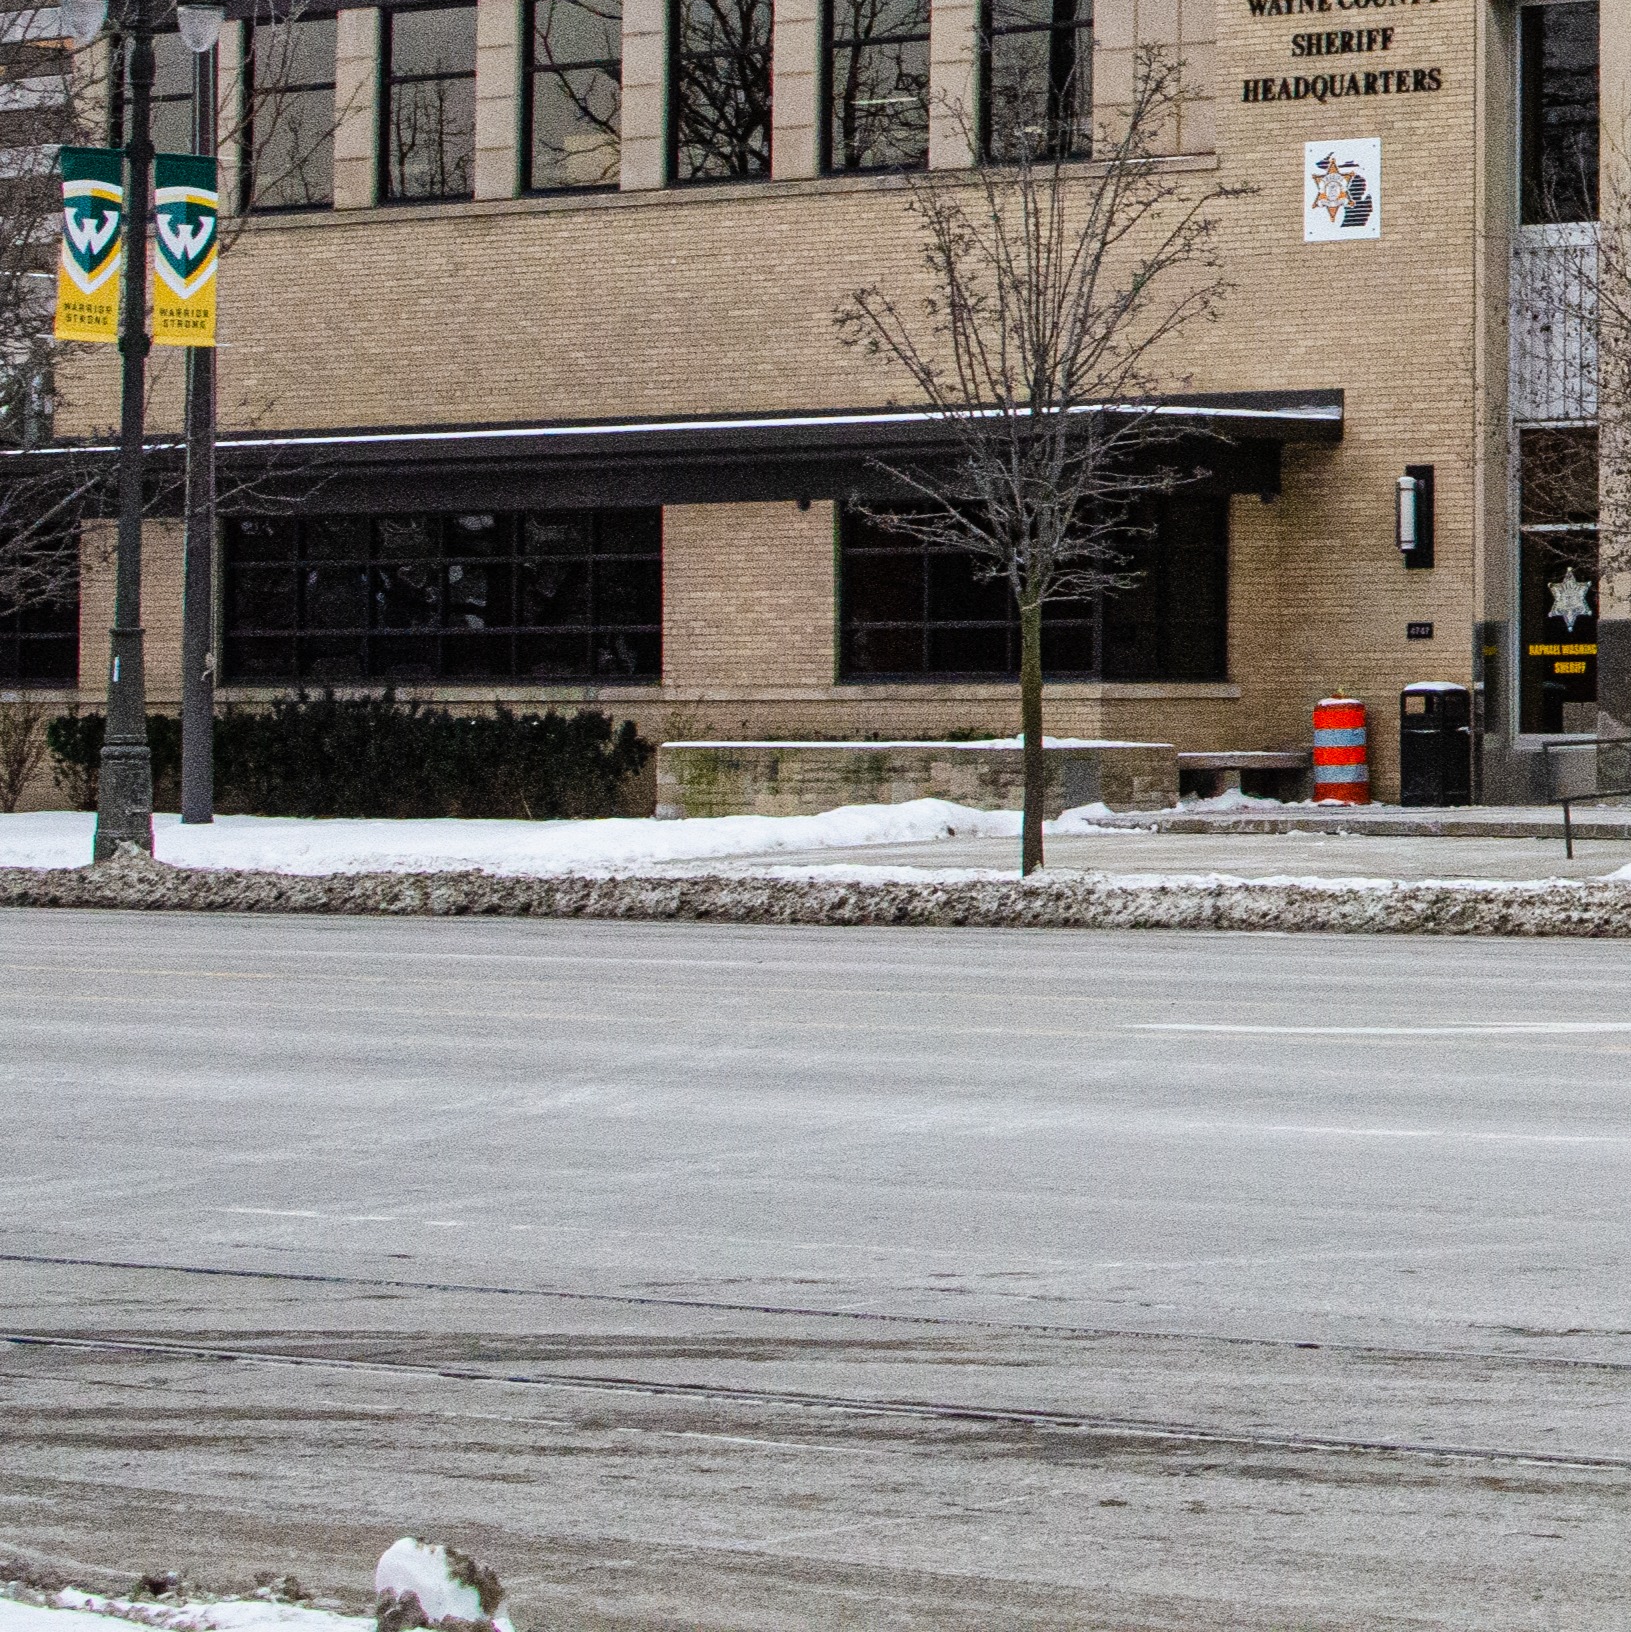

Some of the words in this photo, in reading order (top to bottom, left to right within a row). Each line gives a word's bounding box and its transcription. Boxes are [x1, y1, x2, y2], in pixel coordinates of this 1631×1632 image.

[1291, 27, 1395, 57] SHERIFF
[1241, 68, 1442, 103] HEADQUARTERS
[64, 207, 119, 255] W
[156, 214, 215, 260] W
[64, 302, 112, 313] WARRIOR
[159, 307, 209, 318] WARRIOR
[65, 313, 108, 325] STRONG
[163, 319, 206, 330] STRONG
